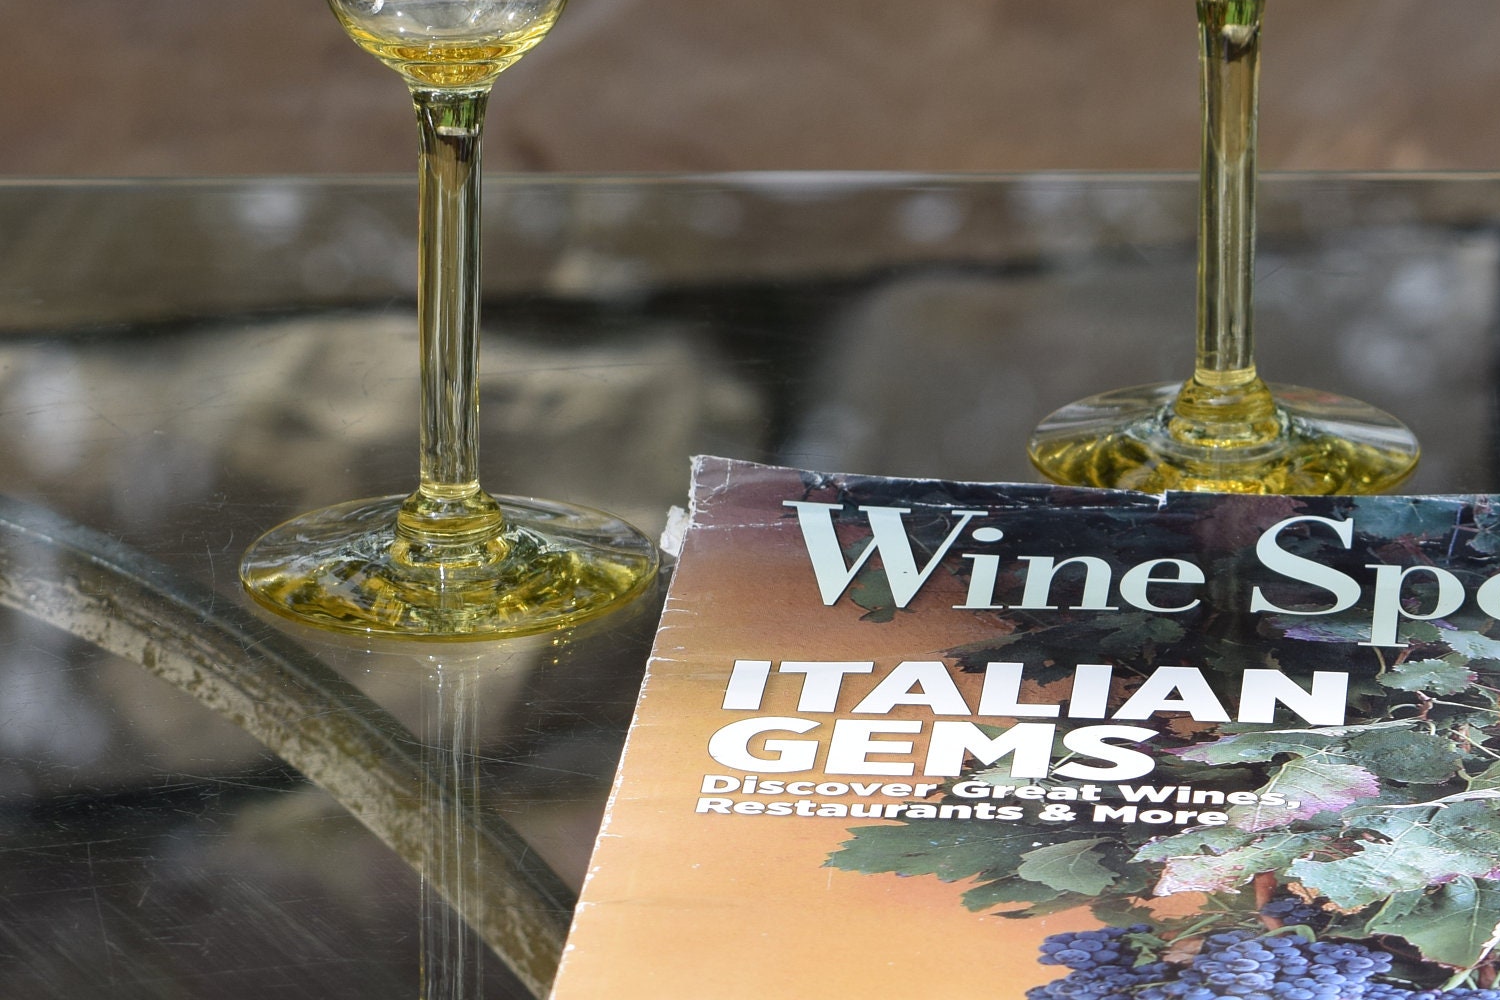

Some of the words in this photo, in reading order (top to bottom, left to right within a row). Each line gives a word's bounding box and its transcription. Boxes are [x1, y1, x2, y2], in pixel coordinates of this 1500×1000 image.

[784, 500, 1205, 612] Wine
[723, 660, 1349, 726] ITALIAN
[707, 716, 1160, 780] GEMS
[695, 797, 1023, 820] Restaurants
[1038, 803, 1077, 821] &
[1093, 805, 1229, 825] More
[700, 774, 938, 797] Discover
[952, 781, 1102, 801] Great
[1117, 784, 1301, 808] Wines,
